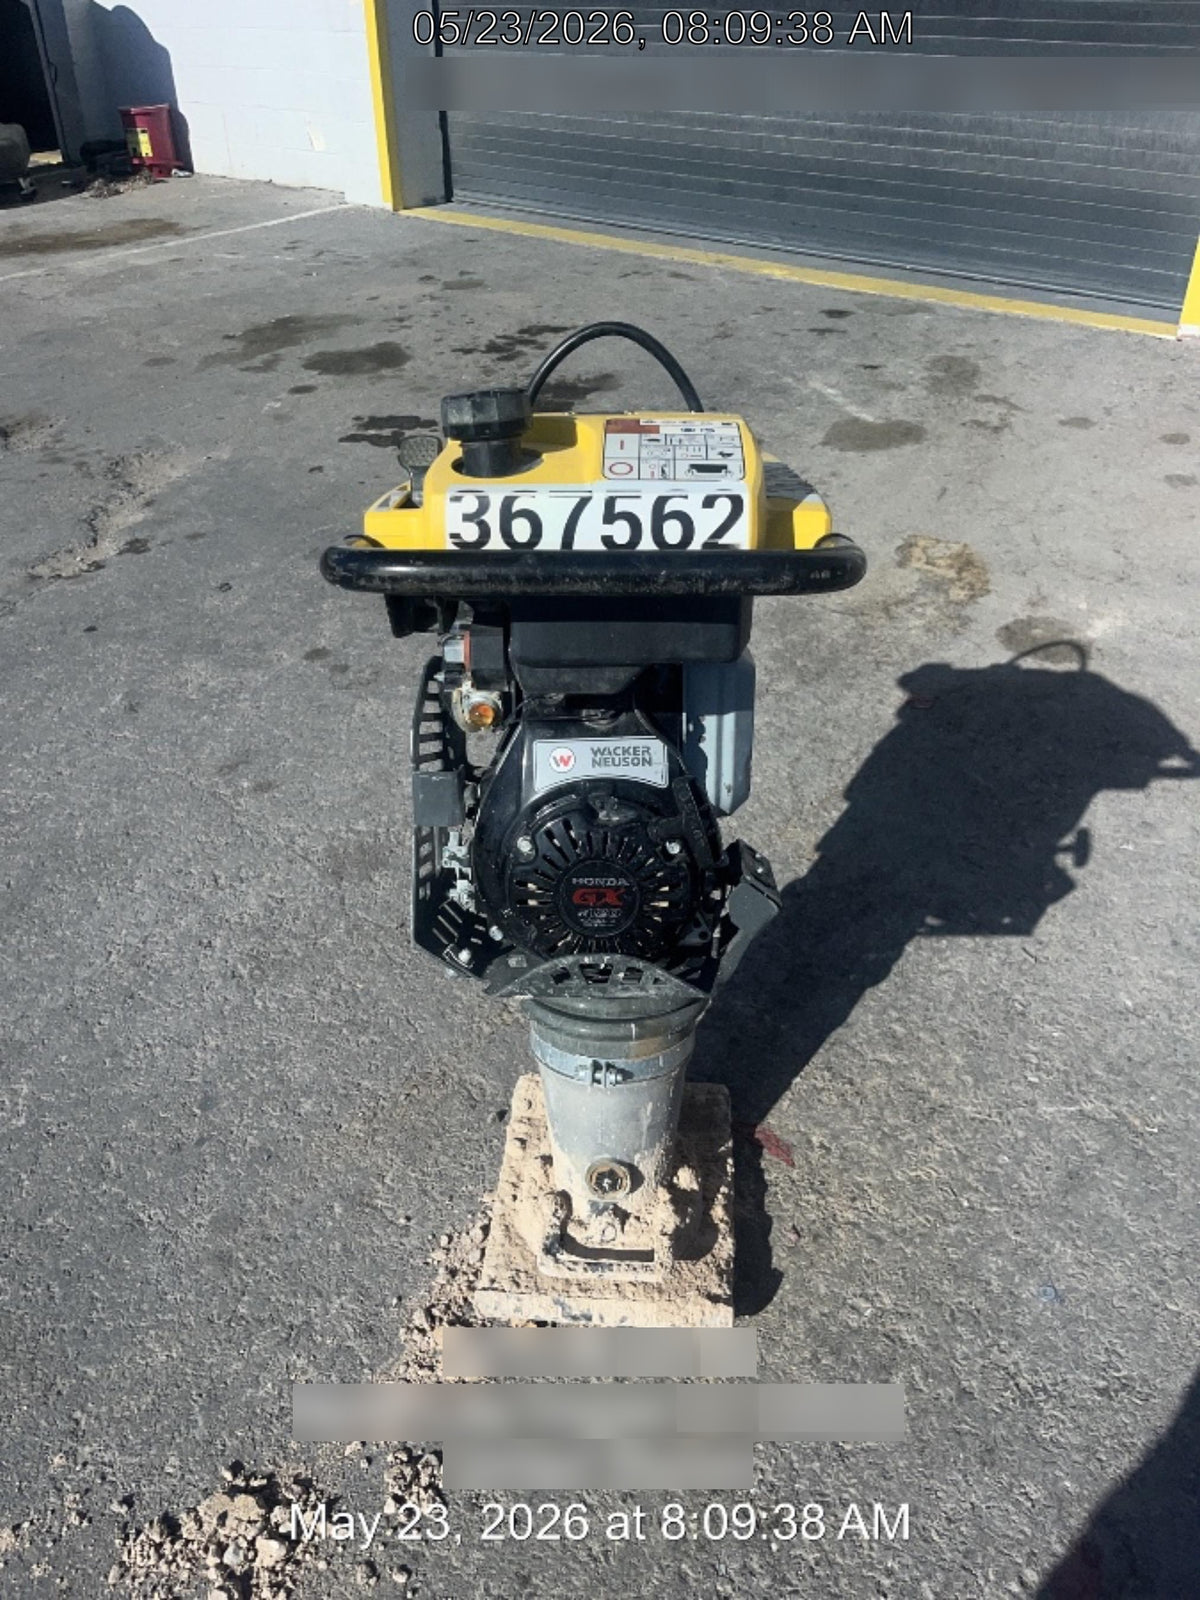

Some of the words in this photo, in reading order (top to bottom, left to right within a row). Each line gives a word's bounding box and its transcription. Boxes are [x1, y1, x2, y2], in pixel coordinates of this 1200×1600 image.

[449, 490, 744, 550] 367562
[590, 746, 652, 757] WACKER
[591, 757, 653, 768] NEUSON
[572, 878, 630, 886] HONDA
[572, 888, 627, 907] GX
